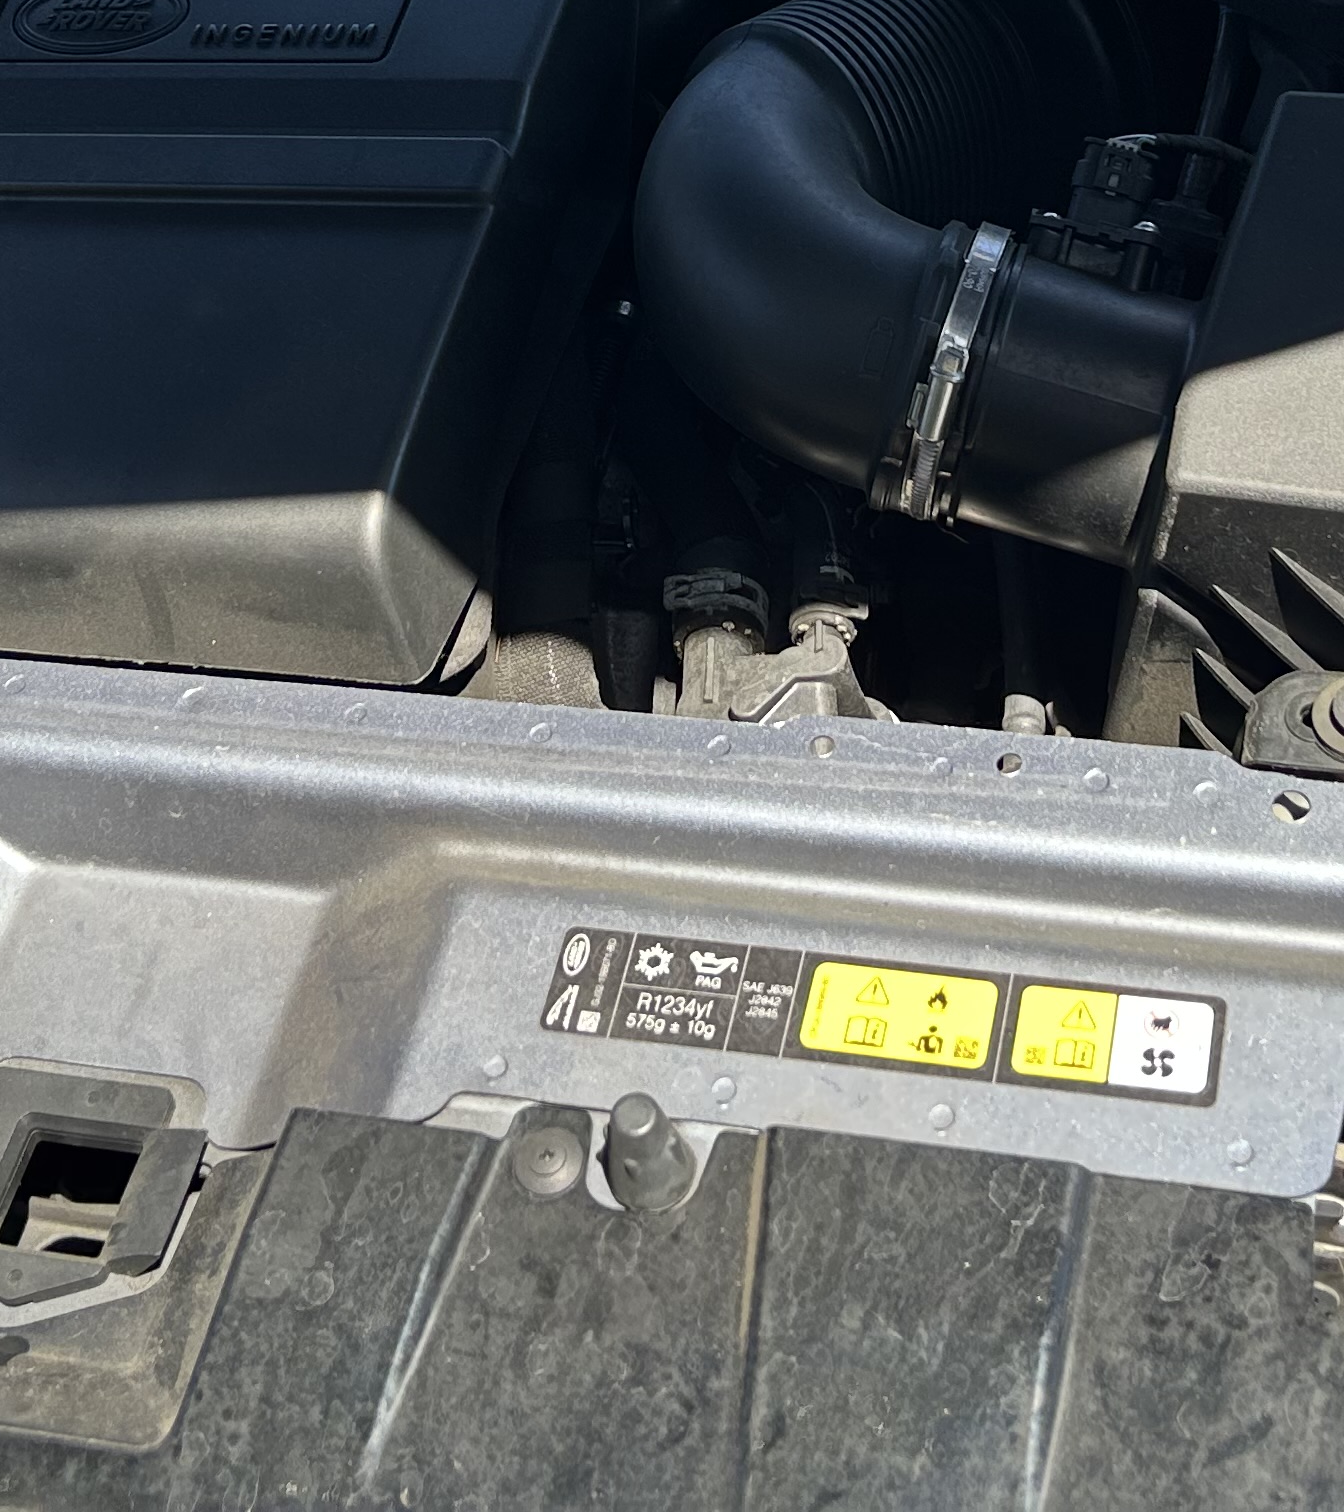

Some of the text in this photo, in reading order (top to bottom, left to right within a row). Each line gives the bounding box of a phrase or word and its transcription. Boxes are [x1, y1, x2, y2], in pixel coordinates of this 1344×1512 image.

[50, 10, 152, 33] ROVER
[190, 23, 378, 48] INGENIUM
[695, 975, 722, 990] PAG
[742, 980, 794, 997] SAE J639
[636, 992, 714, 1020] R1234yf
[625, 1012, 666, 1035] 575g
[687, 1019, 716, 1041] 10g
